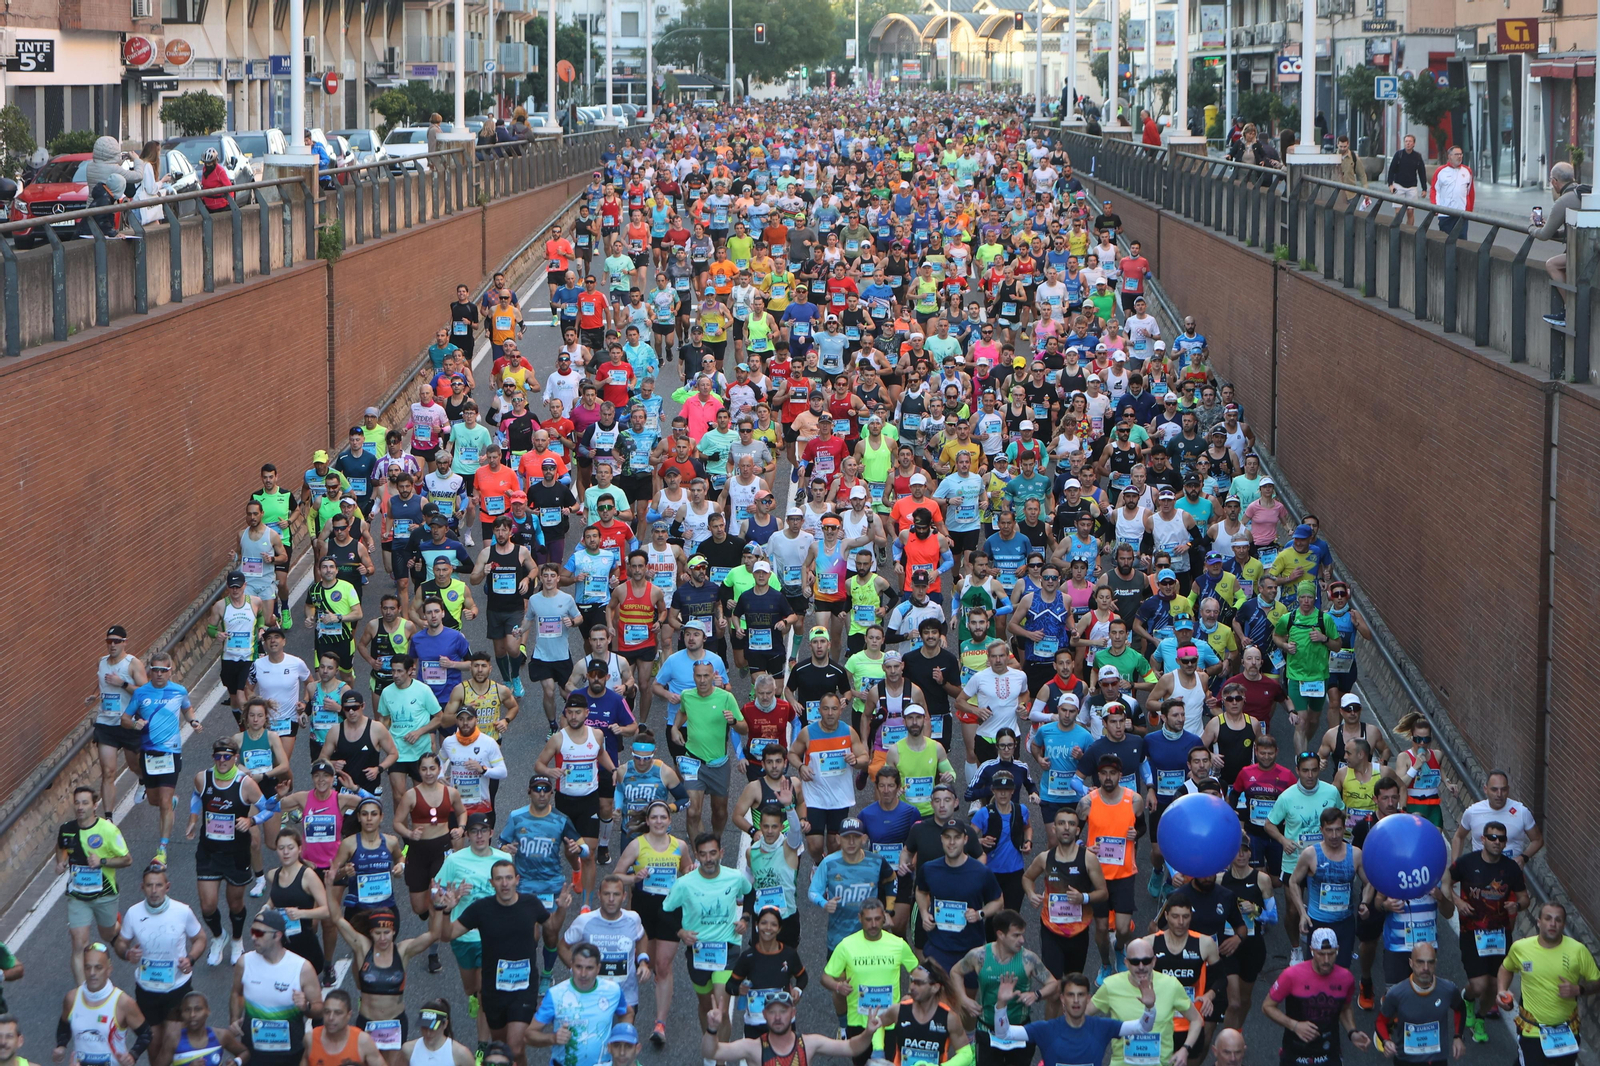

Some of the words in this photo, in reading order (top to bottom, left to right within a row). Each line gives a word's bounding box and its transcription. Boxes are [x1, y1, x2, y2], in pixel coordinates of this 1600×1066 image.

[1365, 22, 1392, 30] HOSTAL
[1380, 80, 1393, 97] P
[1398, 865, 1430, 890] 3:30
[151, 962, 171, 970] ZURICH
[853, 957, 895, 967] TOLETVM
[508, 963, 526, 971] ZURICH
[264, 1022, 286, 1030] ZURICH
[376, 1021, 396, 1030] ZURICH
[1136, 1033, 1156, 1041] ZURICH
[904, 1038, 940, 1052] PACER
[88, 1055, 107, 1063] ZURICH
[914, 1051, 935, 1059] ZURICH
